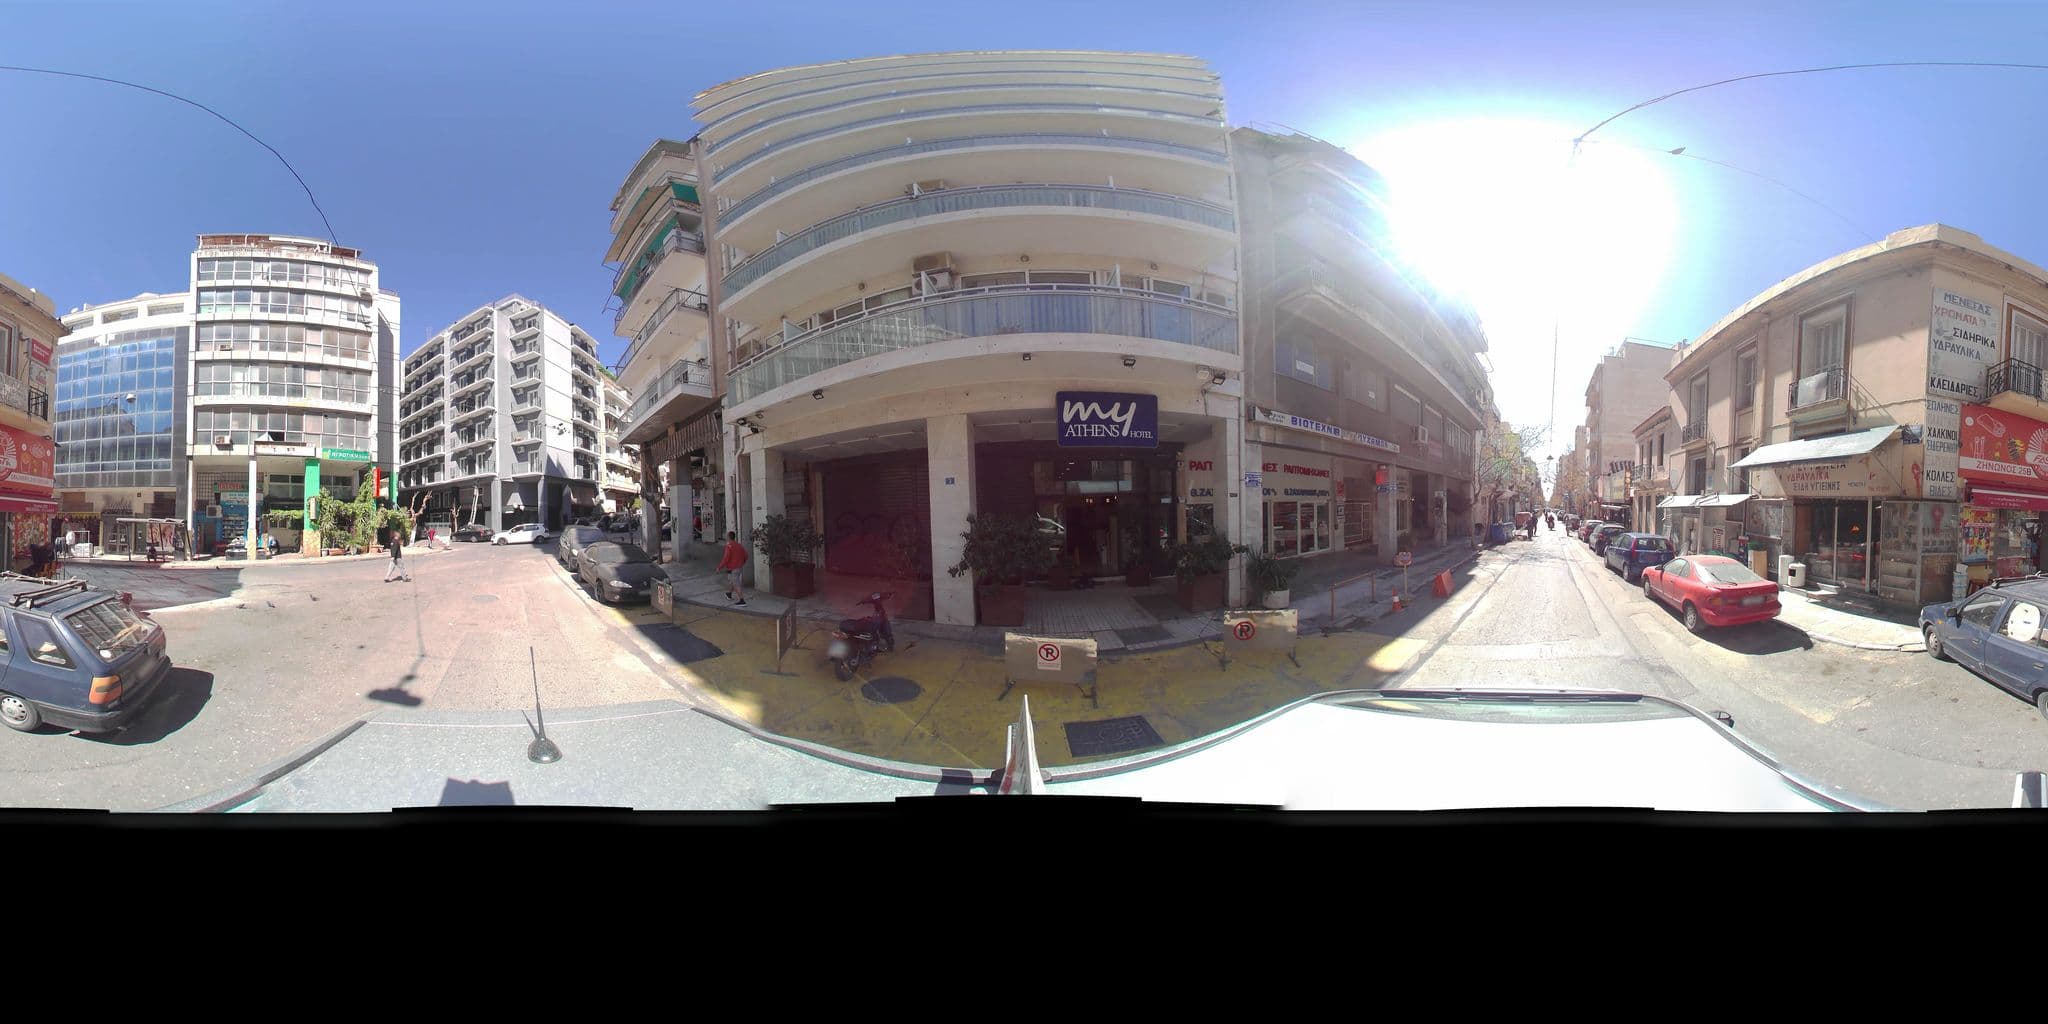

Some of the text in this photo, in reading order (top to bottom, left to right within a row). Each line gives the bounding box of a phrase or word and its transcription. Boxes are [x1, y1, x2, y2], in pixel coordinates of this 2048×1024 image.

[1953, 327, 1996, 349] ΣΙΔΗΡΙΚΑ
[1933, 339, 1981, 360] ΥΔΡΑΥΛΙΚΑ
[1930, 376, 1979, 398] ΚΛΕΙΔΑΡΙΕΣ
[1063, 400, 1136, 437] my
[1065, 424, 1154, 439] ATHENS HOTEL
[1927, 426, 1958, 441] ΧΑΛΚΙΝΟΙ
[1976, 461, 2017, 474] ΖΗΝΩΝΟΣ
[1786, 471, 1829, 482] ΥΔΡΑΥΛΙΚΑ
[1926, 470, 1955, 483] ΚΟΛΛΕΣ
